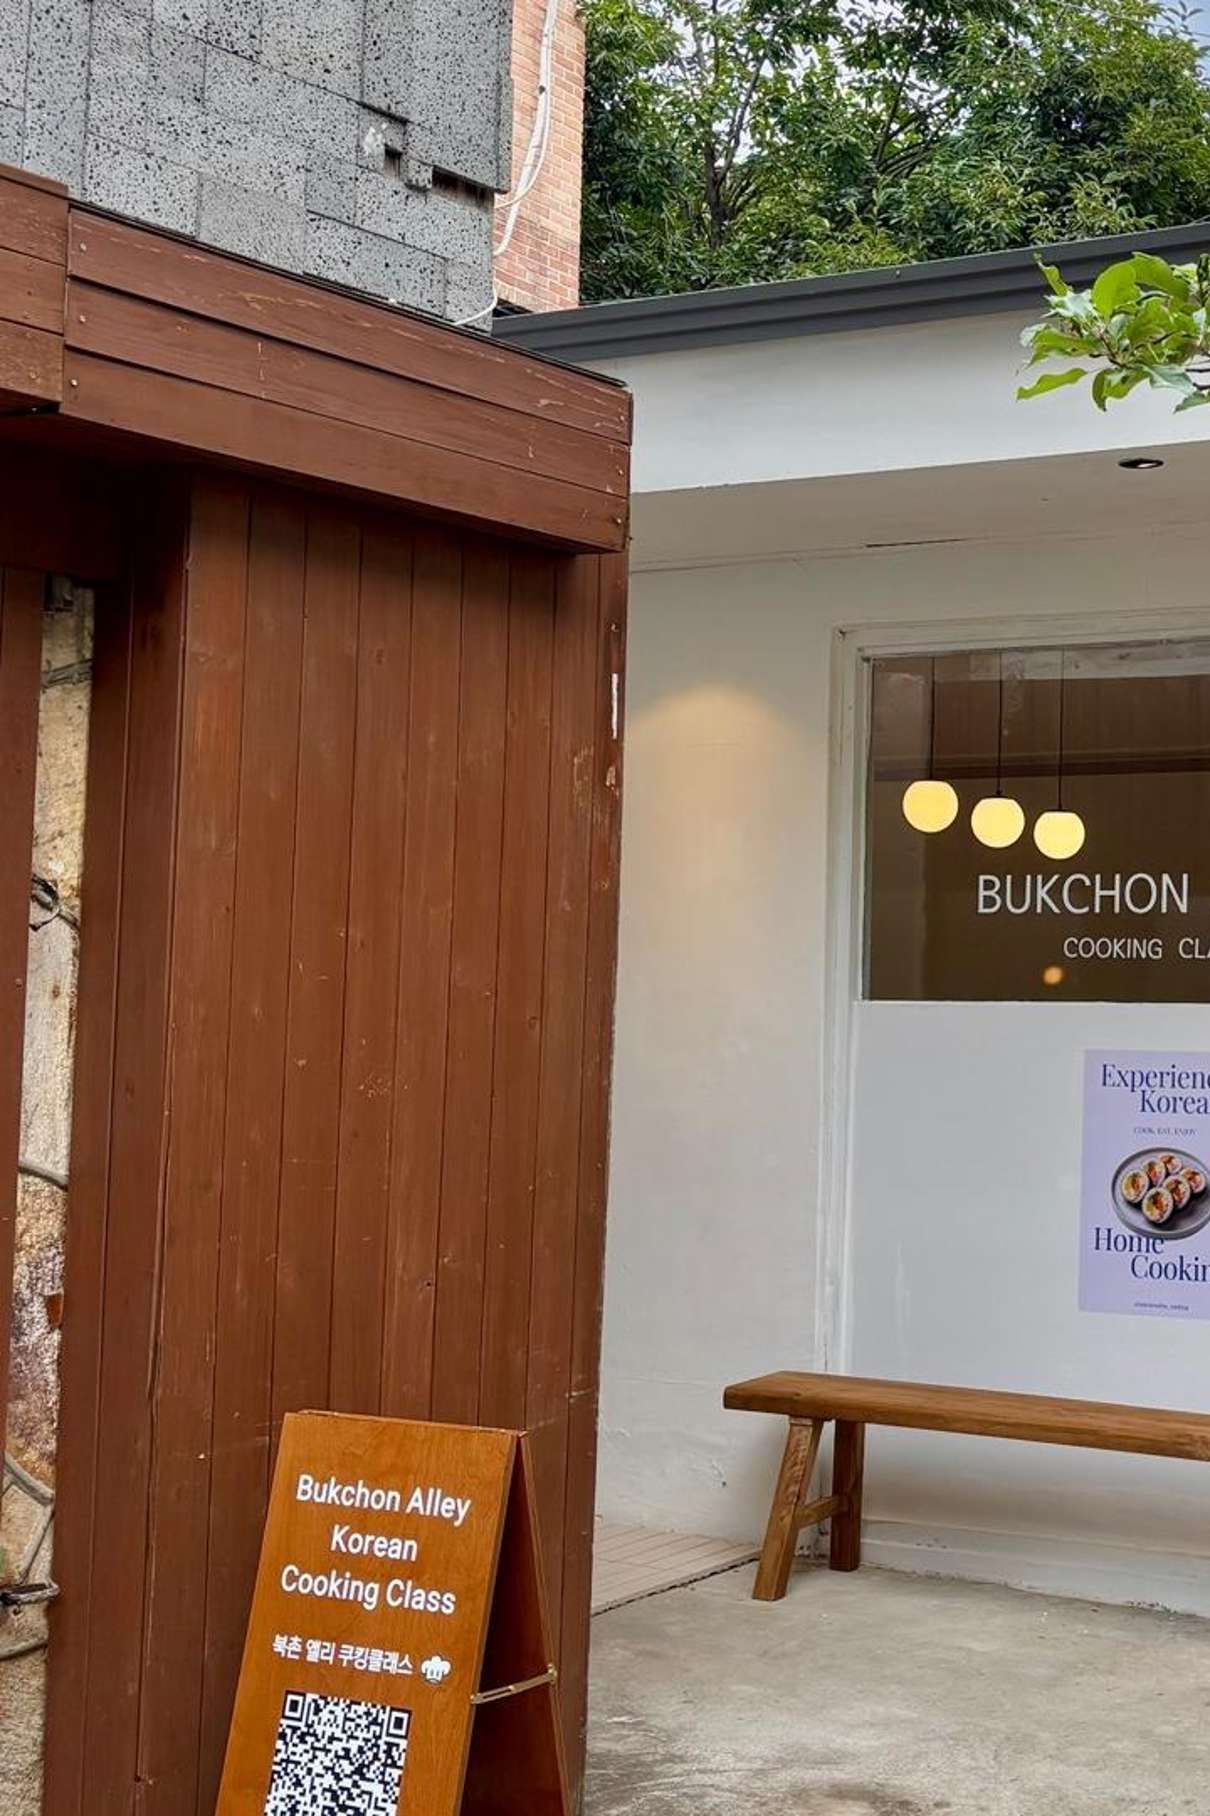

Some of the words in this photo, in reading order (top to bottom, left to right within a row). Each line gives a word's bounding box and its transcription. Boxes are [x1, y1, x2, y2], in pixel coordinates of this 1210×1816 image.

[977, 873, 1189, 915] BUKCHON
[1063, 937, 1163, 960] COOKING
[1094, 1227, 1165, 1254] Home
[296, 1474, 401, 1513] Bukchon
[406, 1486, 472, 1526] Alley
[330, 1524, 418, 1562] Korean
[281, 1564, 381, 1611] Cooking
[386, 1579, 457, 1616] Class
[272, 1633, 303, 1660] 북촌
[337, 1644, 413, 1675] 쿠킹클래스
